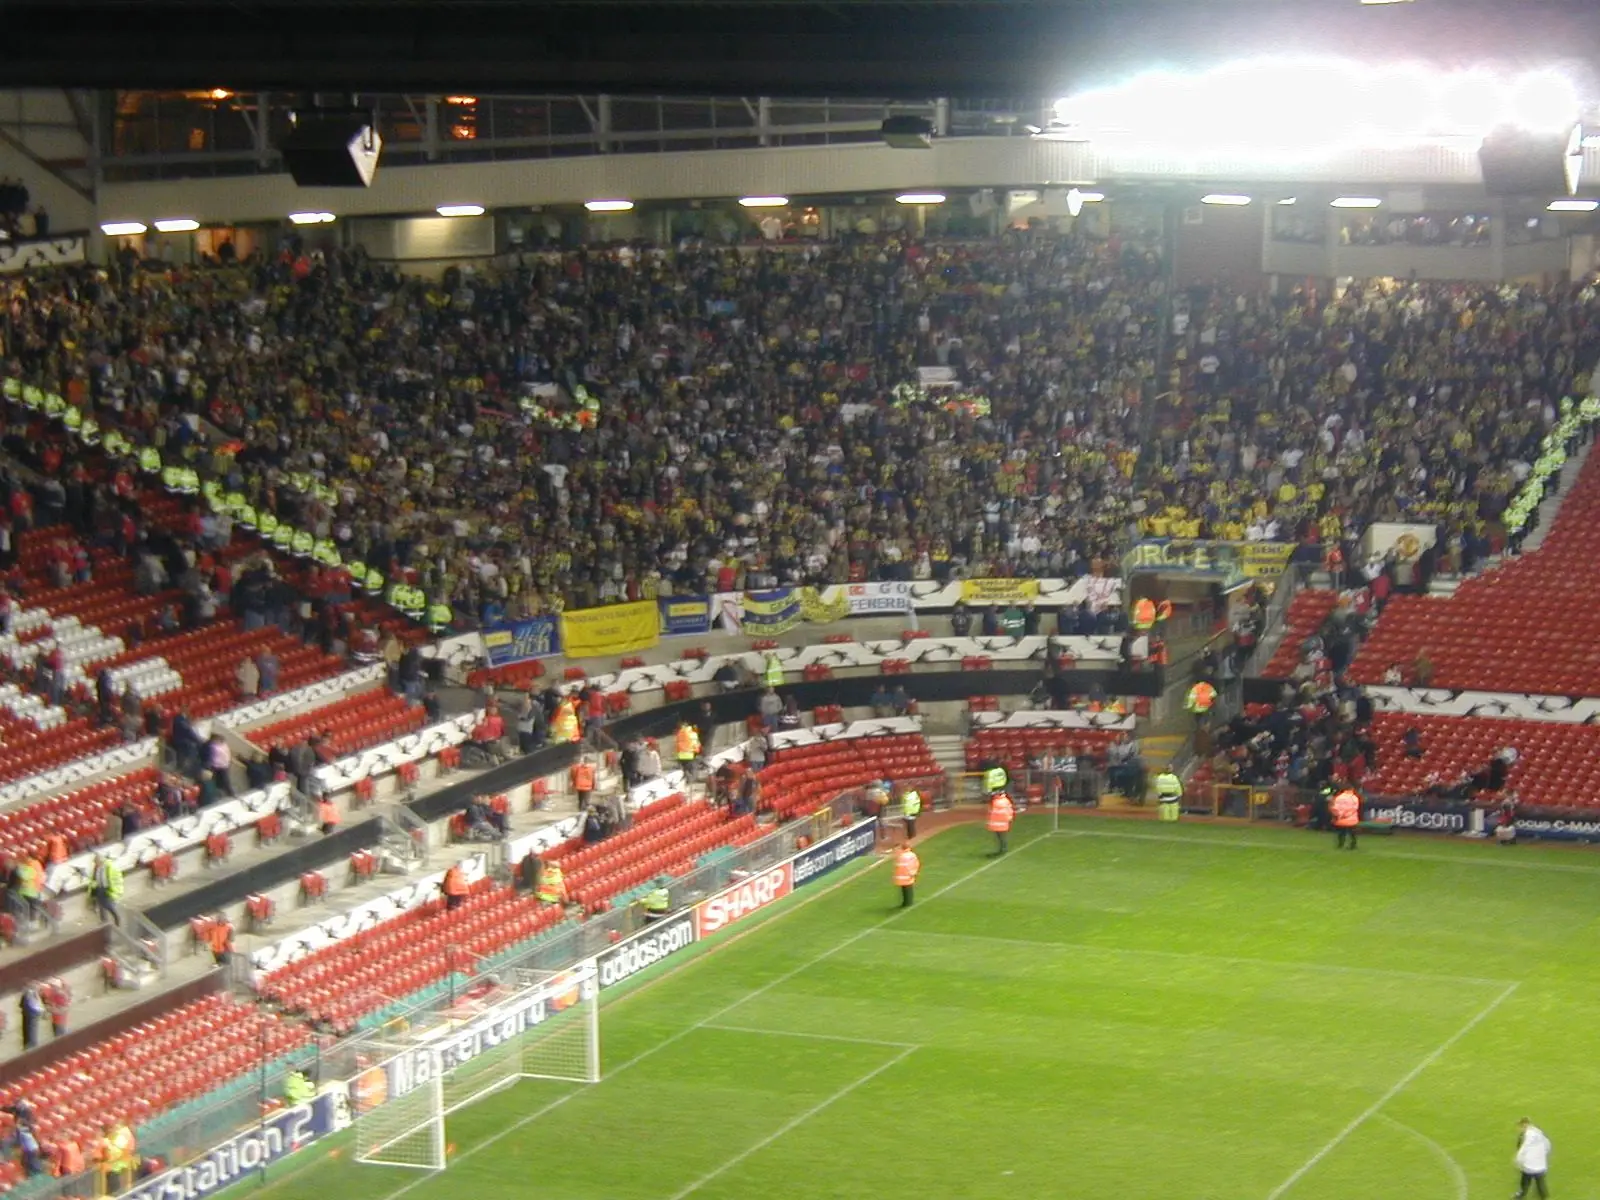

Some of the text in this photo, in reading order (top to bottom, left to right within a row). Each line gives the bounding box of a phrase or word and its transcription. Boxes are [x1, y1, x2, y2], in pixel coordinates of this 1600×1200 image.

[1513, 818, 1551, 830] ocus
[703, 868, 784, 931] SHARP
[601, 920, 693, 986] adidas.com
[291, 1102, 314, 1146] 2
